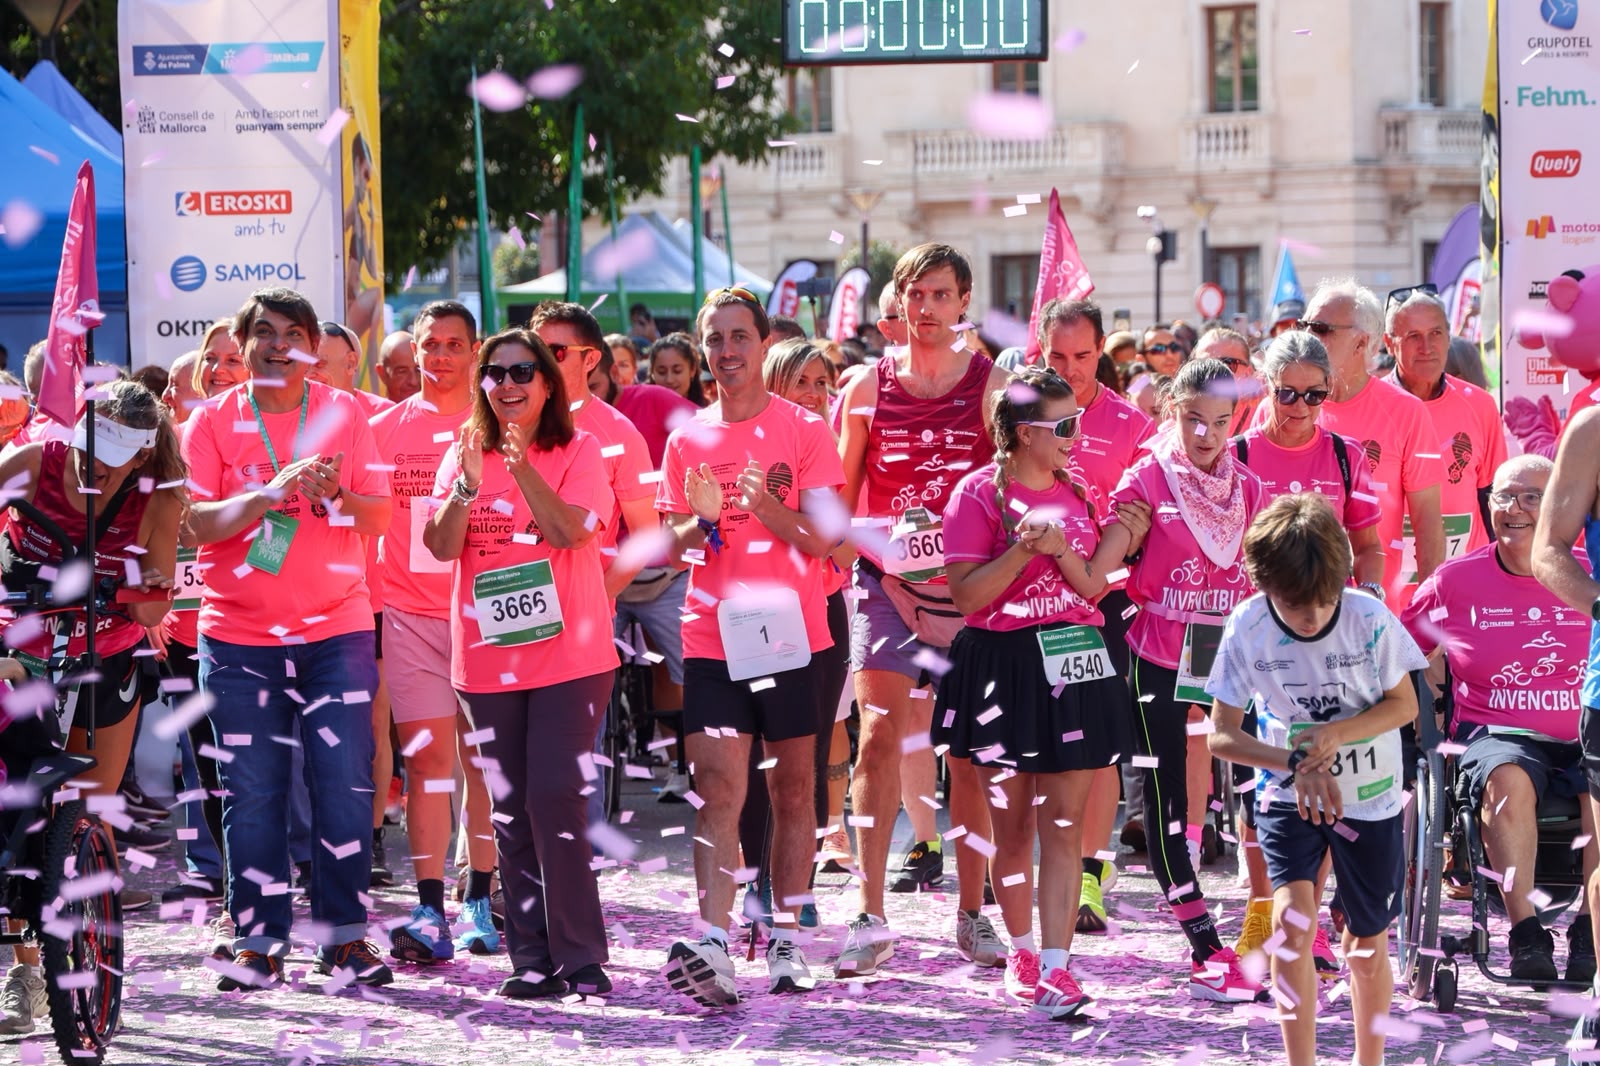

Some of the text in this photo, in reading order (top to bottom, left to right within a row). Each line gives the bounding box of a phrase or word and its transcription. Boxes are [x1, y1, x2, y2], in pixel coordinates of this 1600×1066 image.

[1527, 36, 1593, 49] GRUPOTEL
[157, 53, 196, 61] Ajuntament
[169, 61, 191, 70] Palma
[1517, 86, 1597, 107] Fehm.
[159, 110, 214, 121] Consell de
[235, 109, 319, 121] Amb l'esport net
[160, 123, 207, 133] Mallorca
[235, 121, 284, 134] guanyam
[1533, 155, 1579, 174] Quely
[210, 194, 287, 212] EROSKI
[234, 219, 265, 236] amb
[215, 263, 306, 281] SAMPOL
[1528, 371, 1558, 383] Hora
[393, 470, 407, 480] En
[491, 590, 547, 622] 3666
[760, 625, 769, 644] 1
[1061, 653, 1104, 682] 4540
[1297, 696, 1340, 711] SOM
